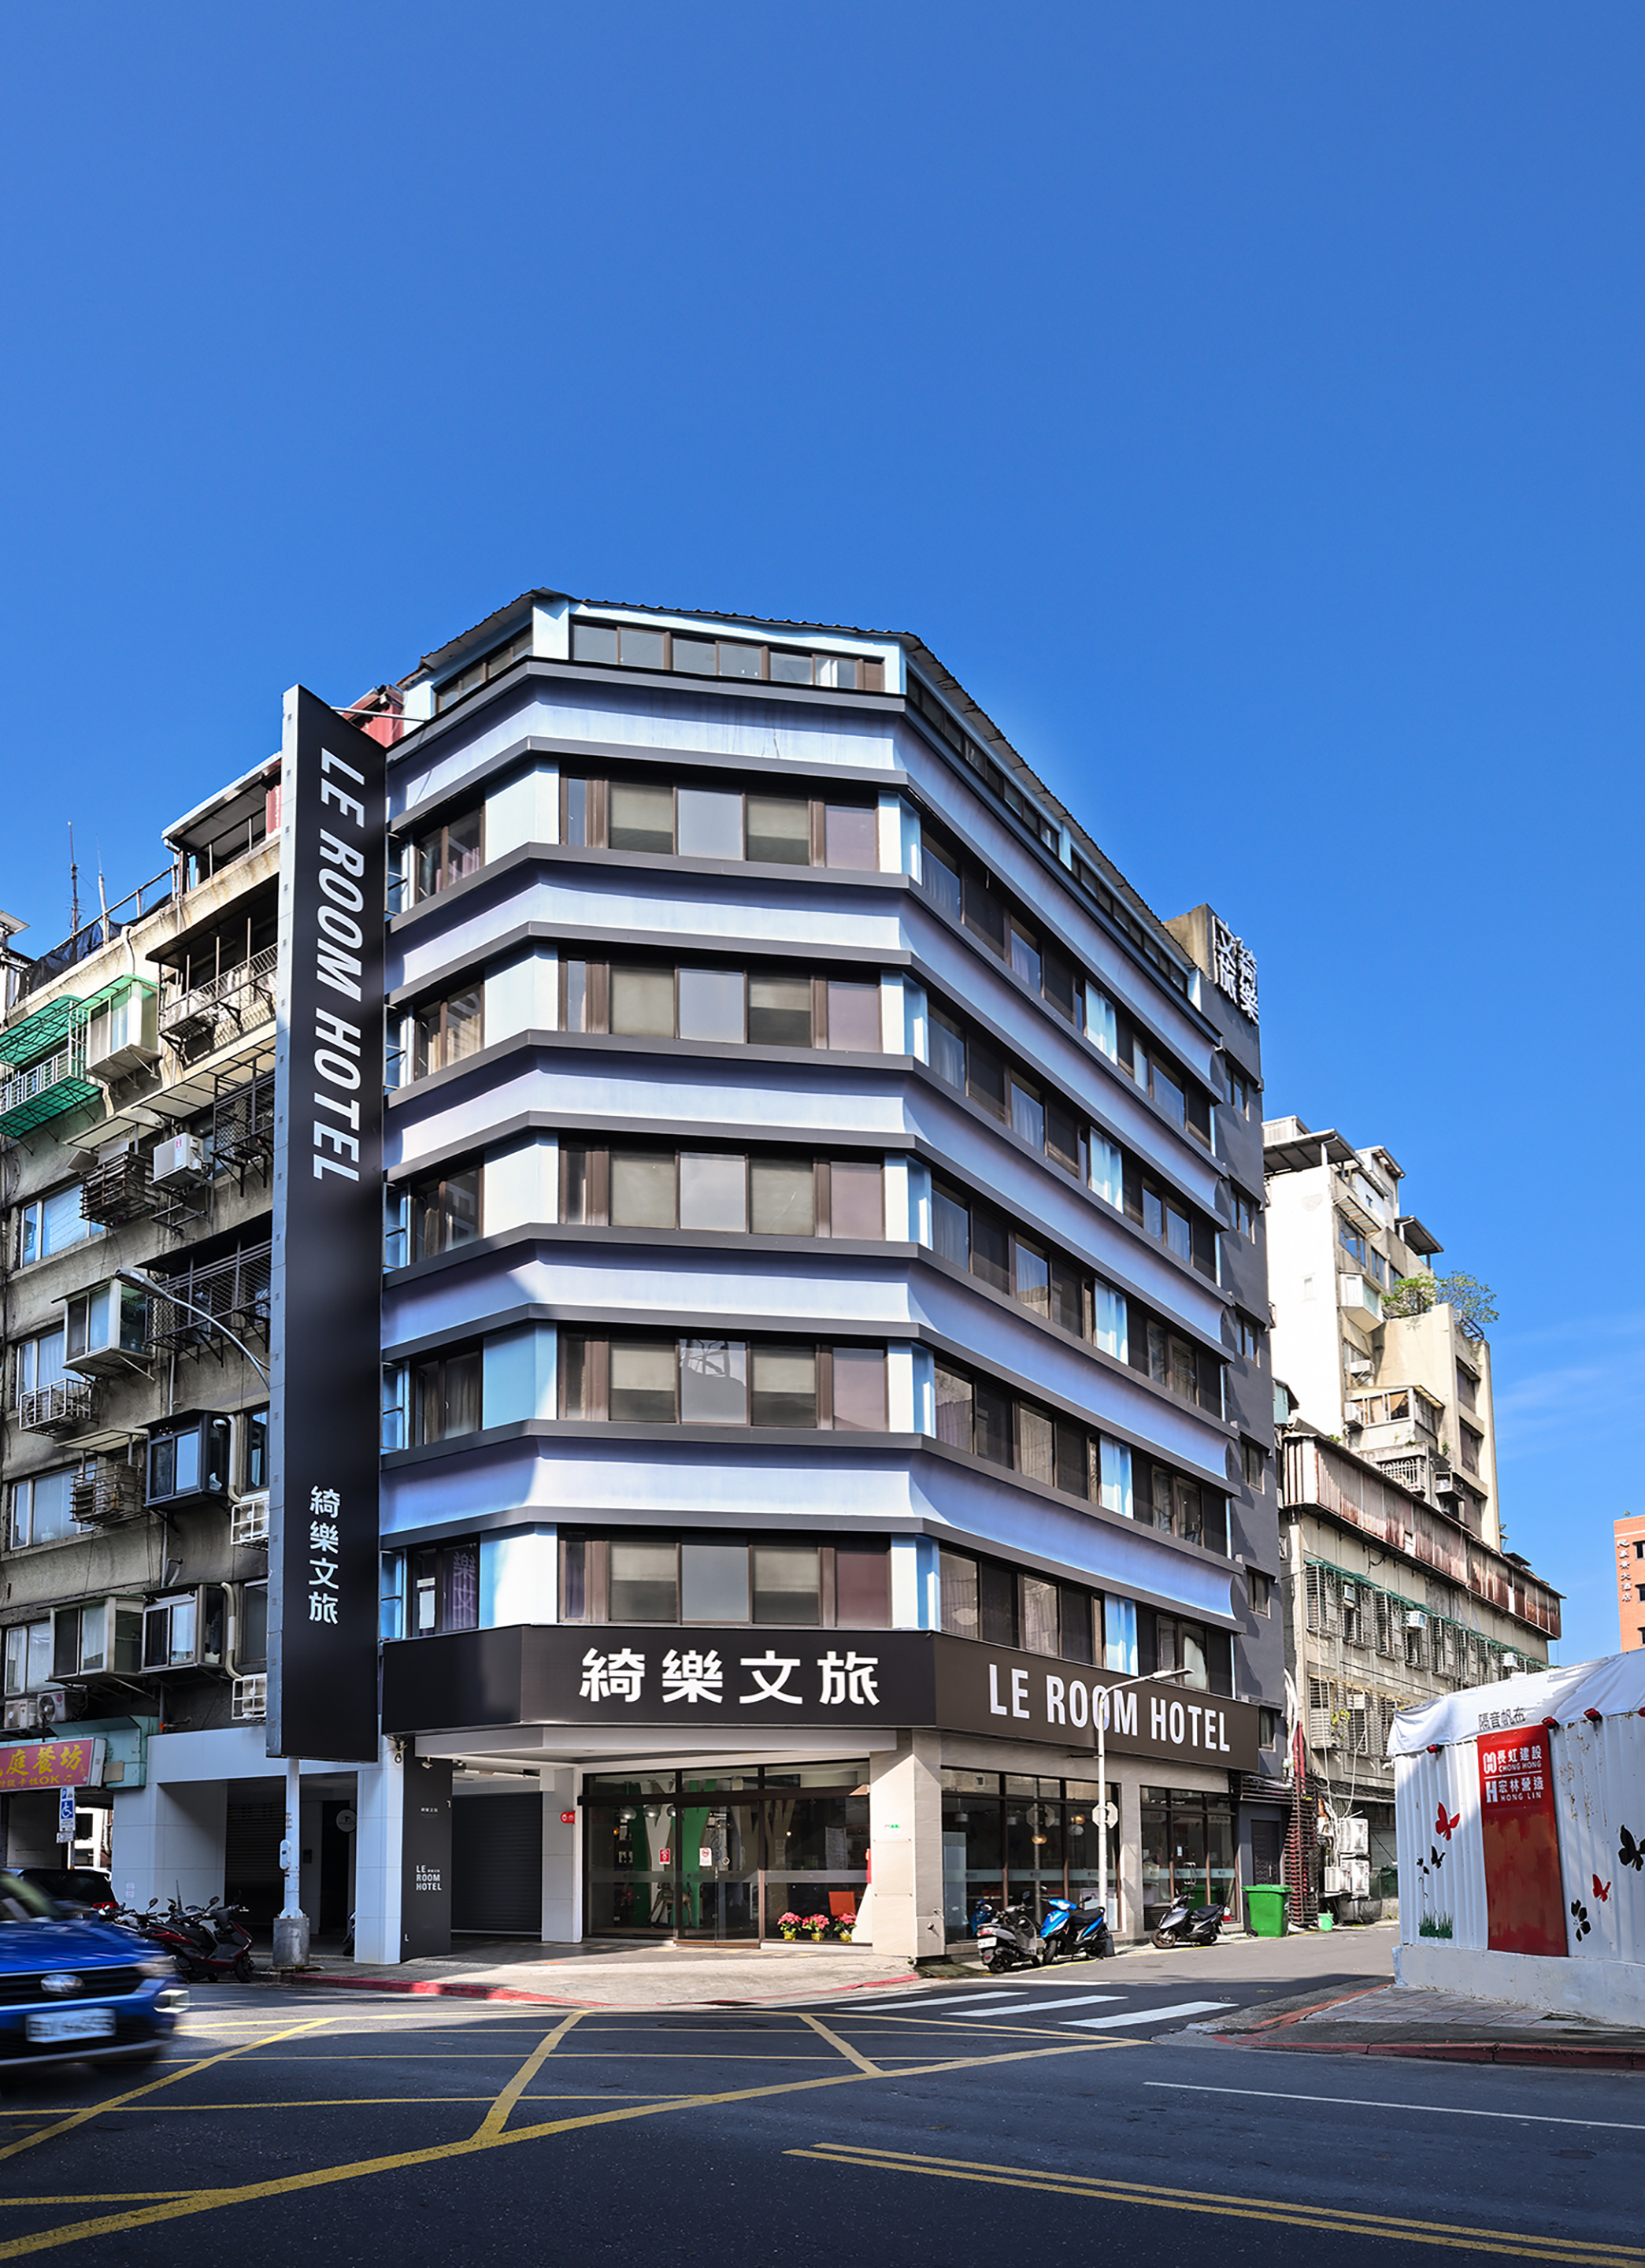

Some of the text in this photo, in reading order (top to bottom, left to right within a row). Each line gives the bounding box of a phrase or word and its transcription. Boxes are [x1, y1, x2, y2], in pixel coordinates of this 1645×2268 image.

[312, 747, 365, 1182] LE ROOM HOTEL
[309, 1485, 340, 1625] 綺樂文旅
[579, 1647, 880, 1707] 綺樂文旅
[989, 1663, 1231, 1752] LE ROOM HOTEL
[0, 1744, 83, 1776] 庭餐坊
[1497, 1745, 1542, 1764] 長虹建設
[1499, 1760, 1541, 1773] CHONG HONG
[1498, 1776, 1543, 1793] 宏林營造
[1500, 1792, 1541, 1802] HONG LIN
[416, 1873, 440, 1882] ROOM
[416, 1882, 442, 1891] HOTEL
